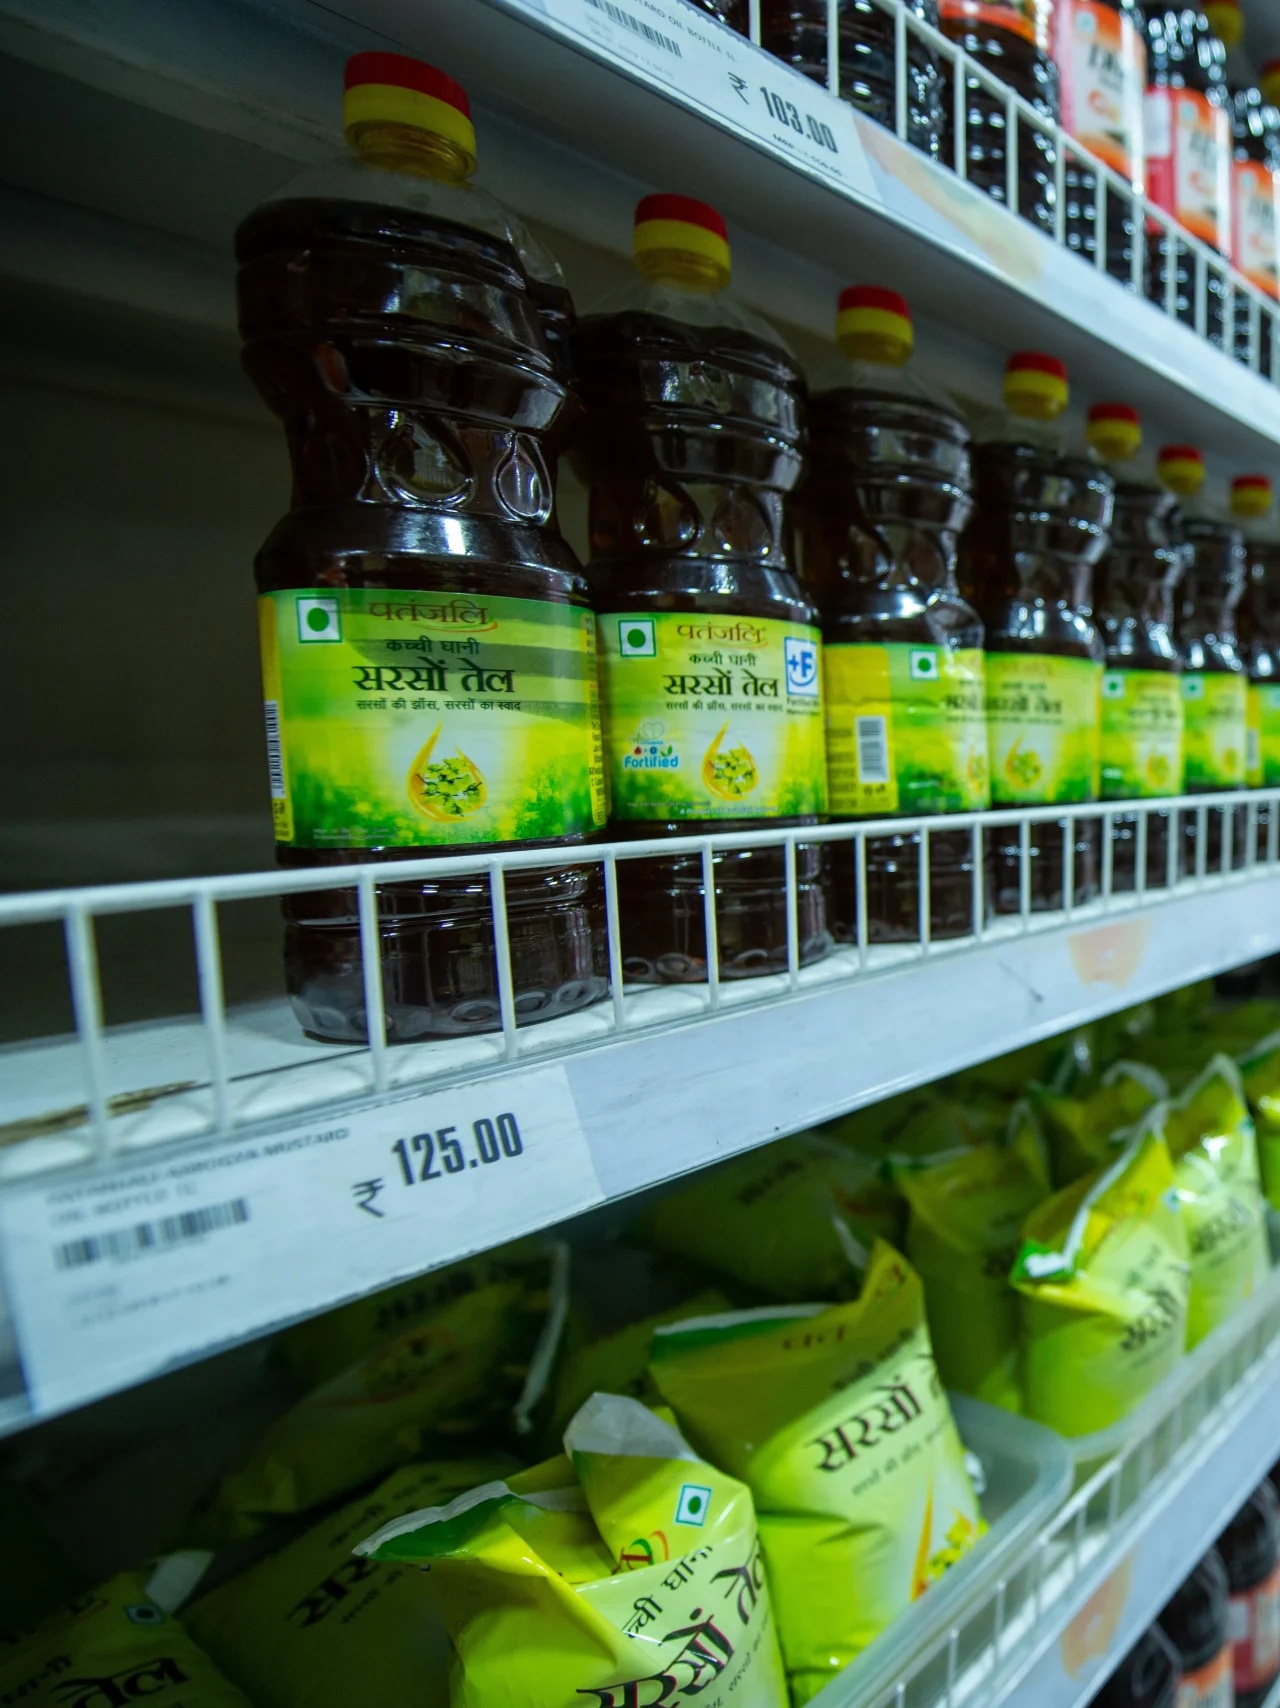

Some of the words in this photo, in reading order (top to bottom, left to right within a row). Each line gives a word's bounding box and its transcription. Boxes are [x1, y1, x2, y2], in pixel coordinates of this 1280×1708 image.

[687, 26, 722, 54] BOTTLE
[759, 86, 839, 154] 103.00
[368, 598, 489, 625] पतंजलि
[385, 635, 433, 653] कच्ची
[439, 637, 480, 655] घानी
[676, 621, 761, 643] पतंजलि
[351, 656, 449, 692] सरसों
[458, 657, 516, 693] तेल
[662, 667, 734, 695] सरसों
[740, 668, 780, 697] तेल
[444, 698, 475, 710] सरसों
[479, 700, 495, 711] का
[391, 1112, 524, 1187] 125.00
[804, 1375, 923, 1472] सरसों
